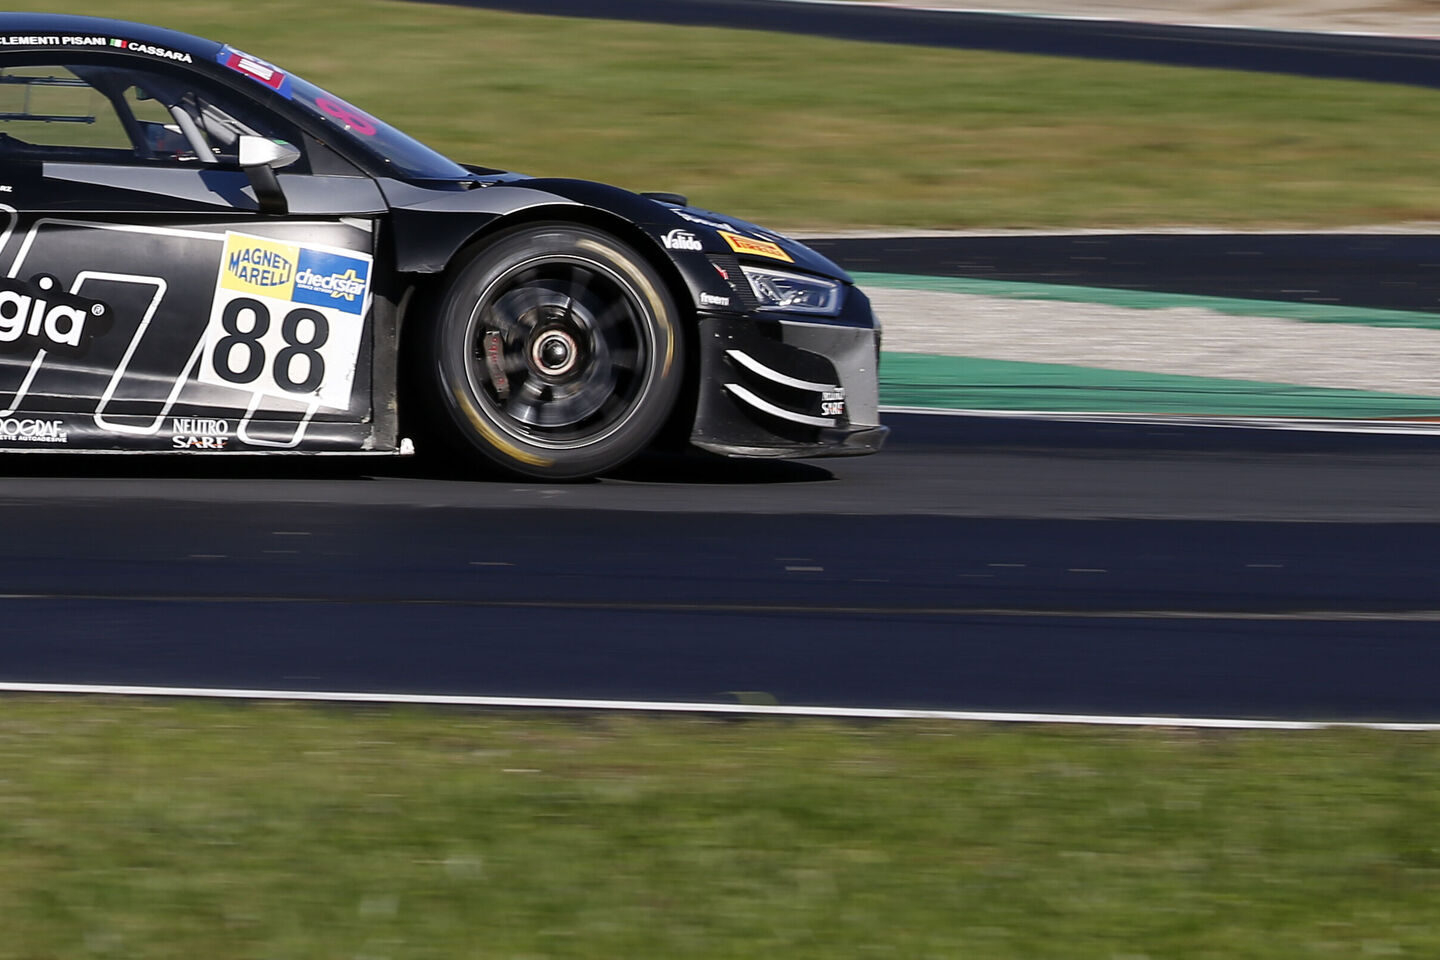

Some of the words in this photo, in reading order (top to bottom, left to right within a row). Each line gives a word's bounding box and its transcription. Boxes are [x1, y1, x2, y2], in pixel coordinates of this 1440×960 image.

[62, 36, 106, 46] PISANI
[128, 42, 193, 64] CASSARÀ
[660, 229, 702, 251] Valido
[295, 268, 365, 295] checkstar
[212, 297, 330, 394] 88
[173, 419, 229, 435] NEUTRO
[172, 435, 229, 449] SARF
